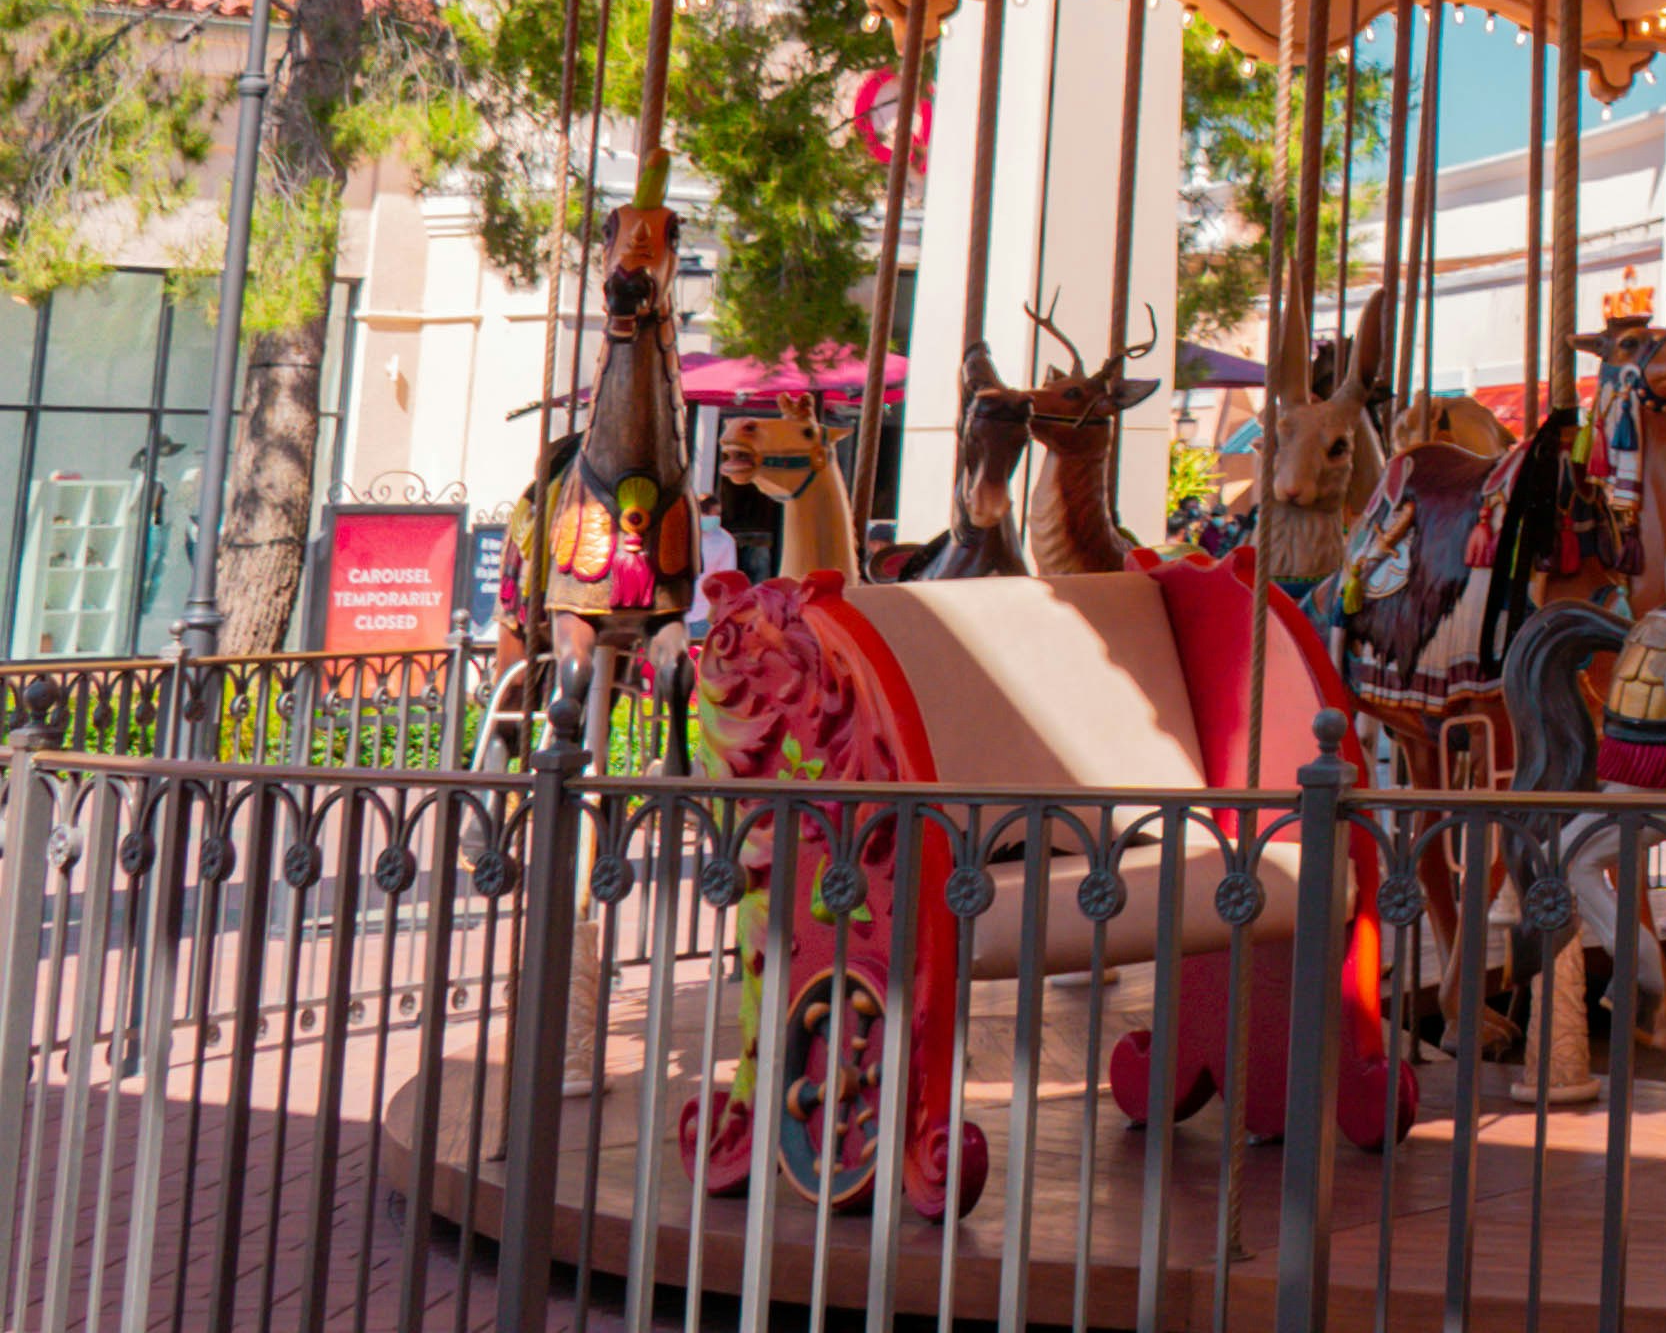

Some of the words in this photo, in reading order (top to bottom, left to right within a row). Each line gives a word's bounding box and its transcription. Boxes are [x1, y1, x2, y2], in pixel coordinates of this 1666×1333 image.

[348, 568, 432, 584] CAROUSEL
[334, 591, 442, 607] TEMPORARILY
[354, 614, 418, 630] CLOSED
